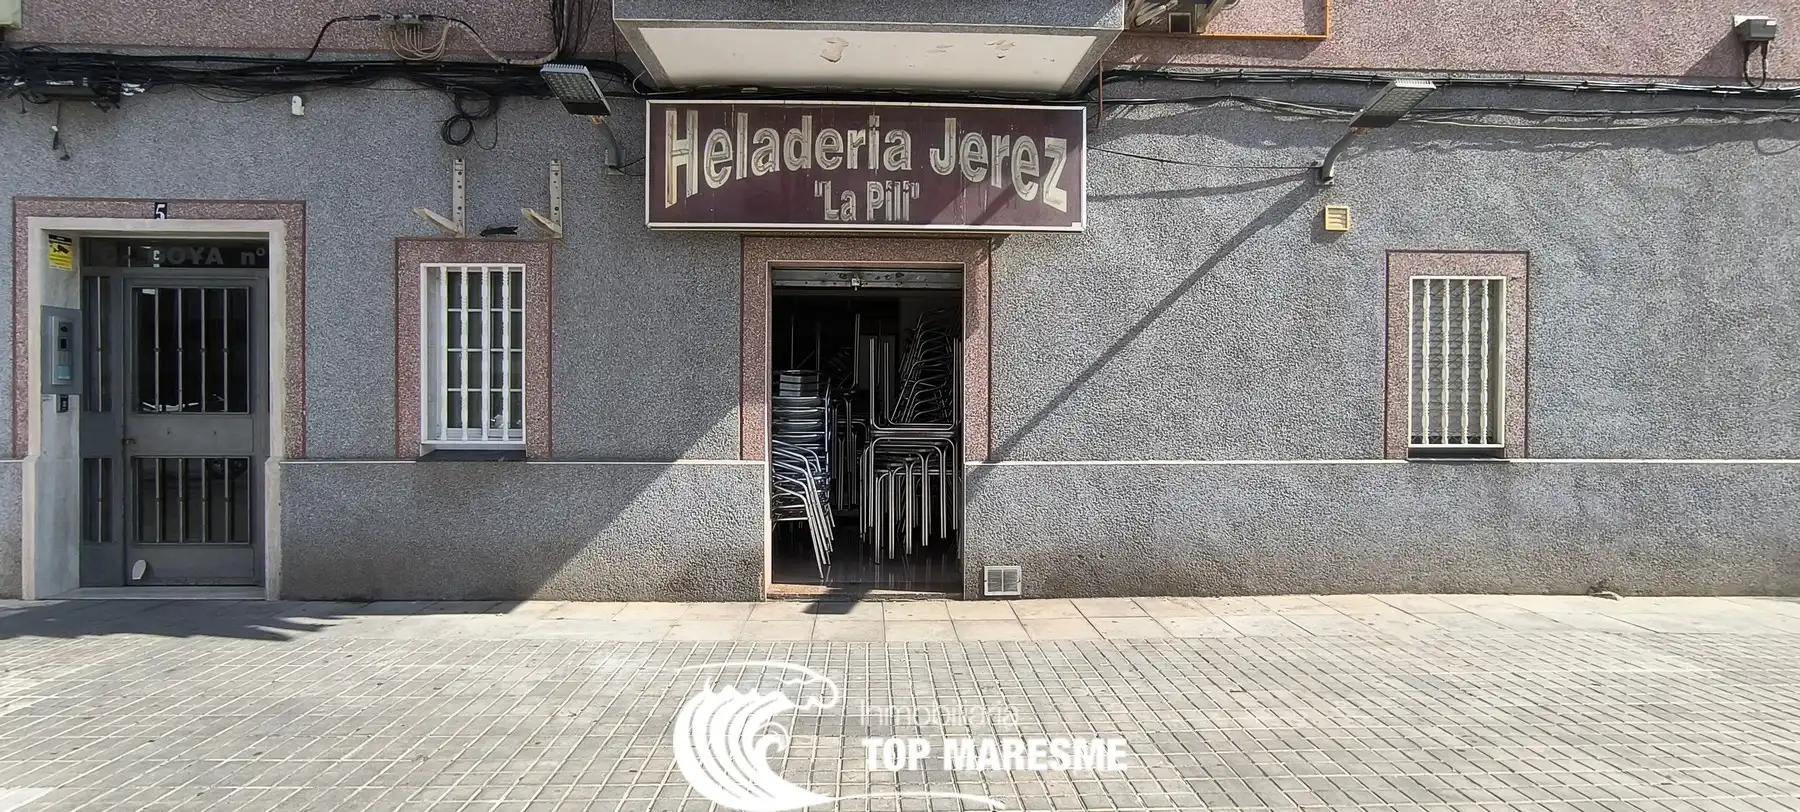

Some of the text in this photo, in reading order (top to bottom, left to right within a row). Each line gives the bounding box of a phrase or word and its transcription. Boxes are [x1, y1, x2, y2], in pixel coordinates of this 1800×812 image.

[664, 107, 1068, 213] Heladeria Jerez
[155, 203, 166, 220] 5
